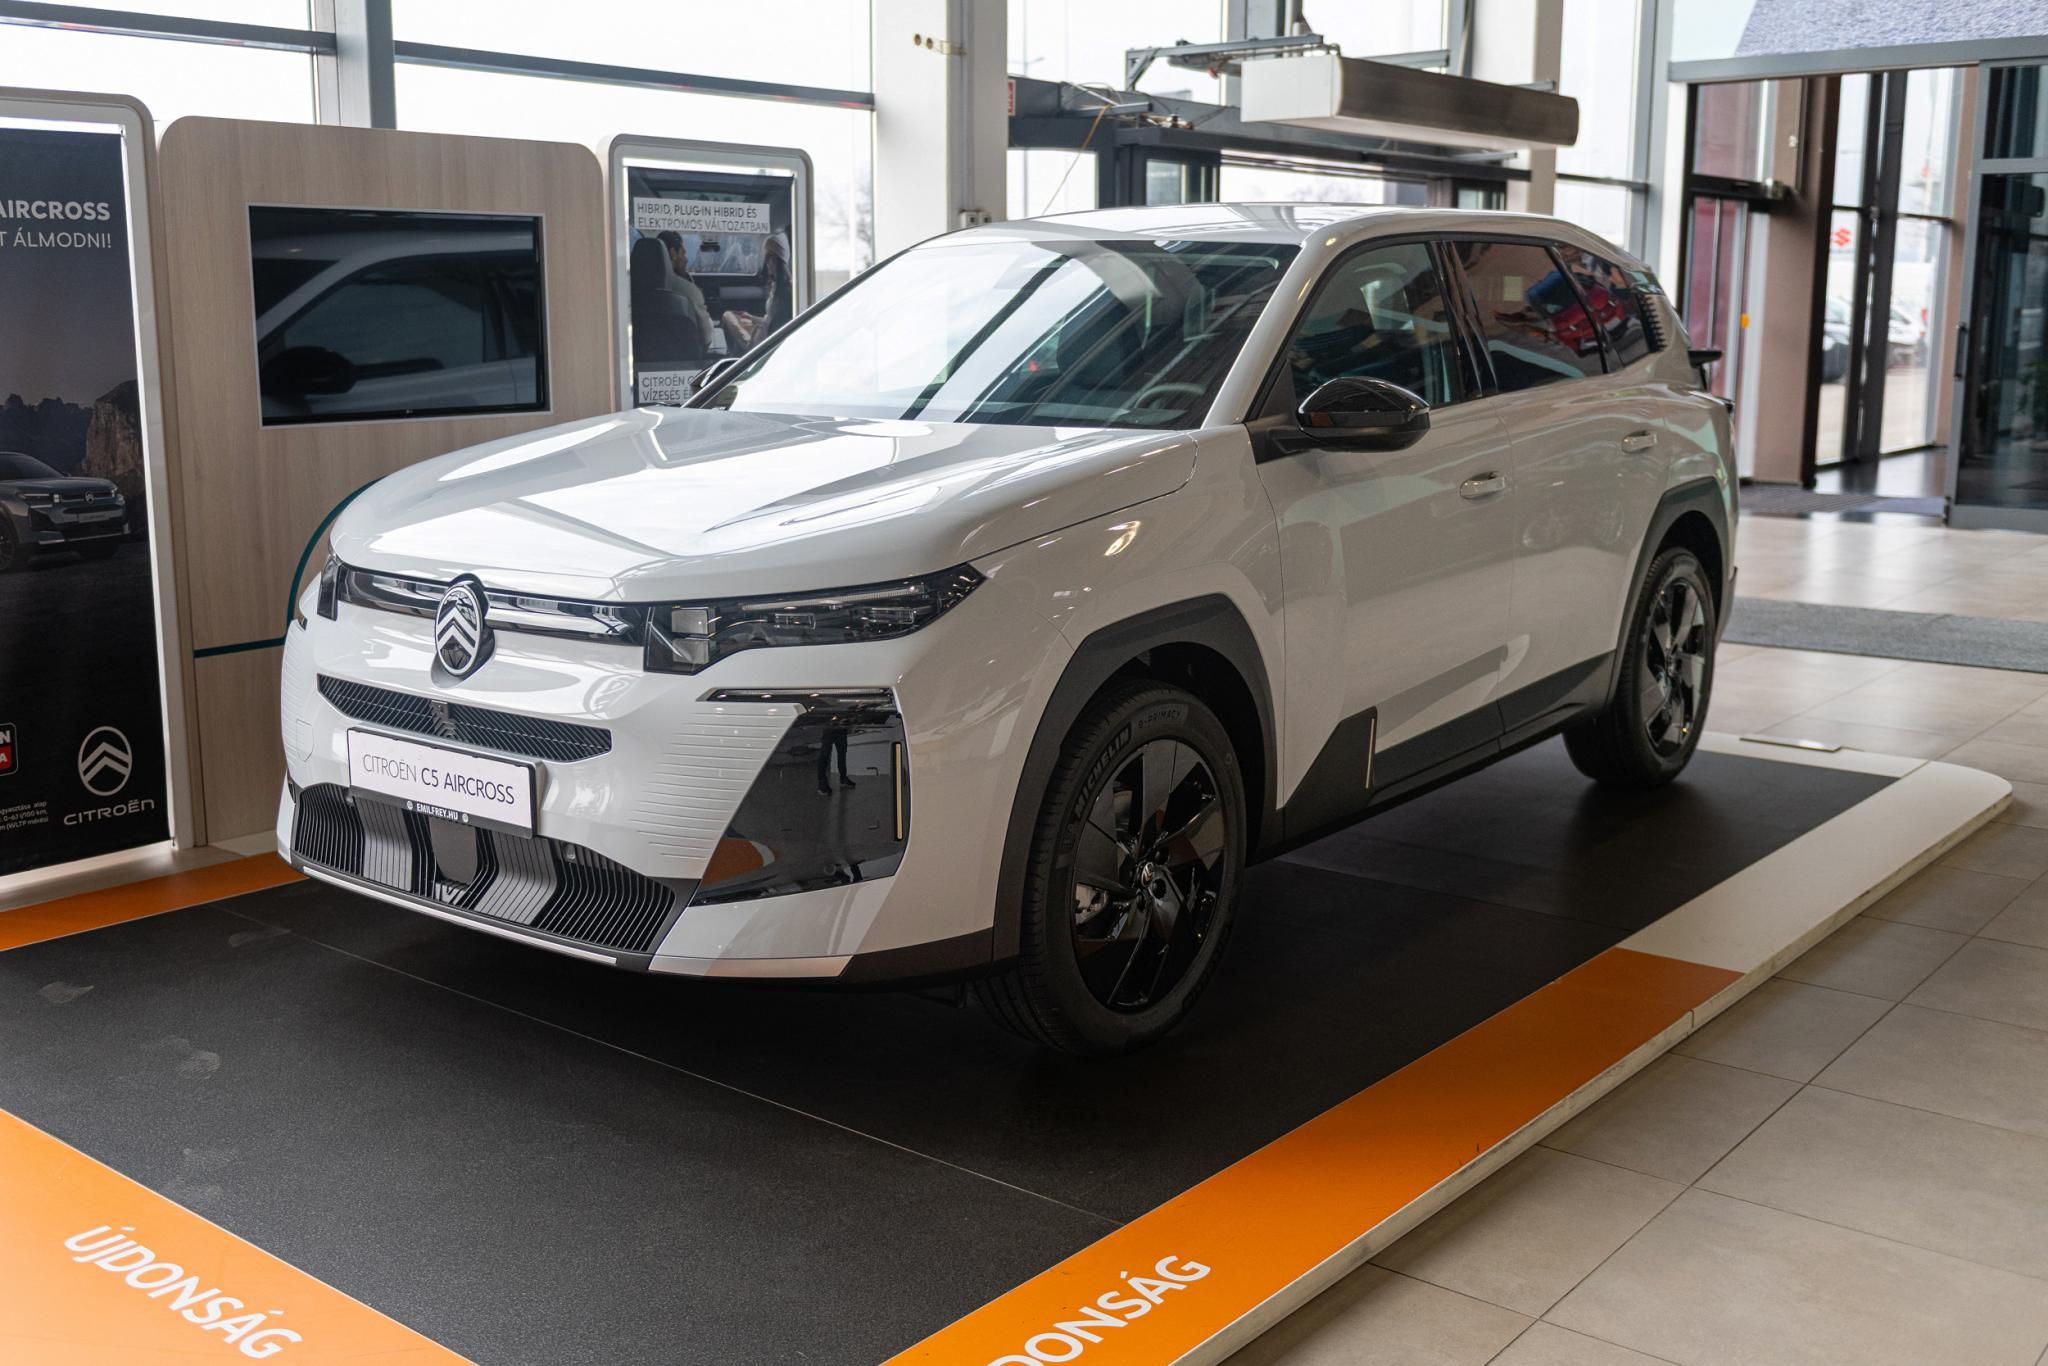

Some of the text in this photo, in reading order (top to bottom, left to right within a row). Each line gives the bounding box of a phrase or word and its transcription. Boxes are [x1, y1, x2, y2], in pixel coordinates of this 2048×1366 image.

[637, 203, 672, 216] HIBRID,
[714, 208, 744, 218] HIBRID
[747, 206, 758, 219] ÉS
[638, 217, 769, 232] ELEKTROMOS VÁLTOZATBAN
[13, 227, 112, 249] ÁLMODNI!
[641, 374, 685, 388] CITROËN
[642, 386, 680, 401] VÍZESÉS
[362, 753, 516, 805] CITROËN C5 AIRCROSS
[1074, 726, 1130, 819] MICHELIN
[416, 802, 459, 821] EMILFREY.HU
[63, 1224, 303, 1360] ÚJDONSÁG
